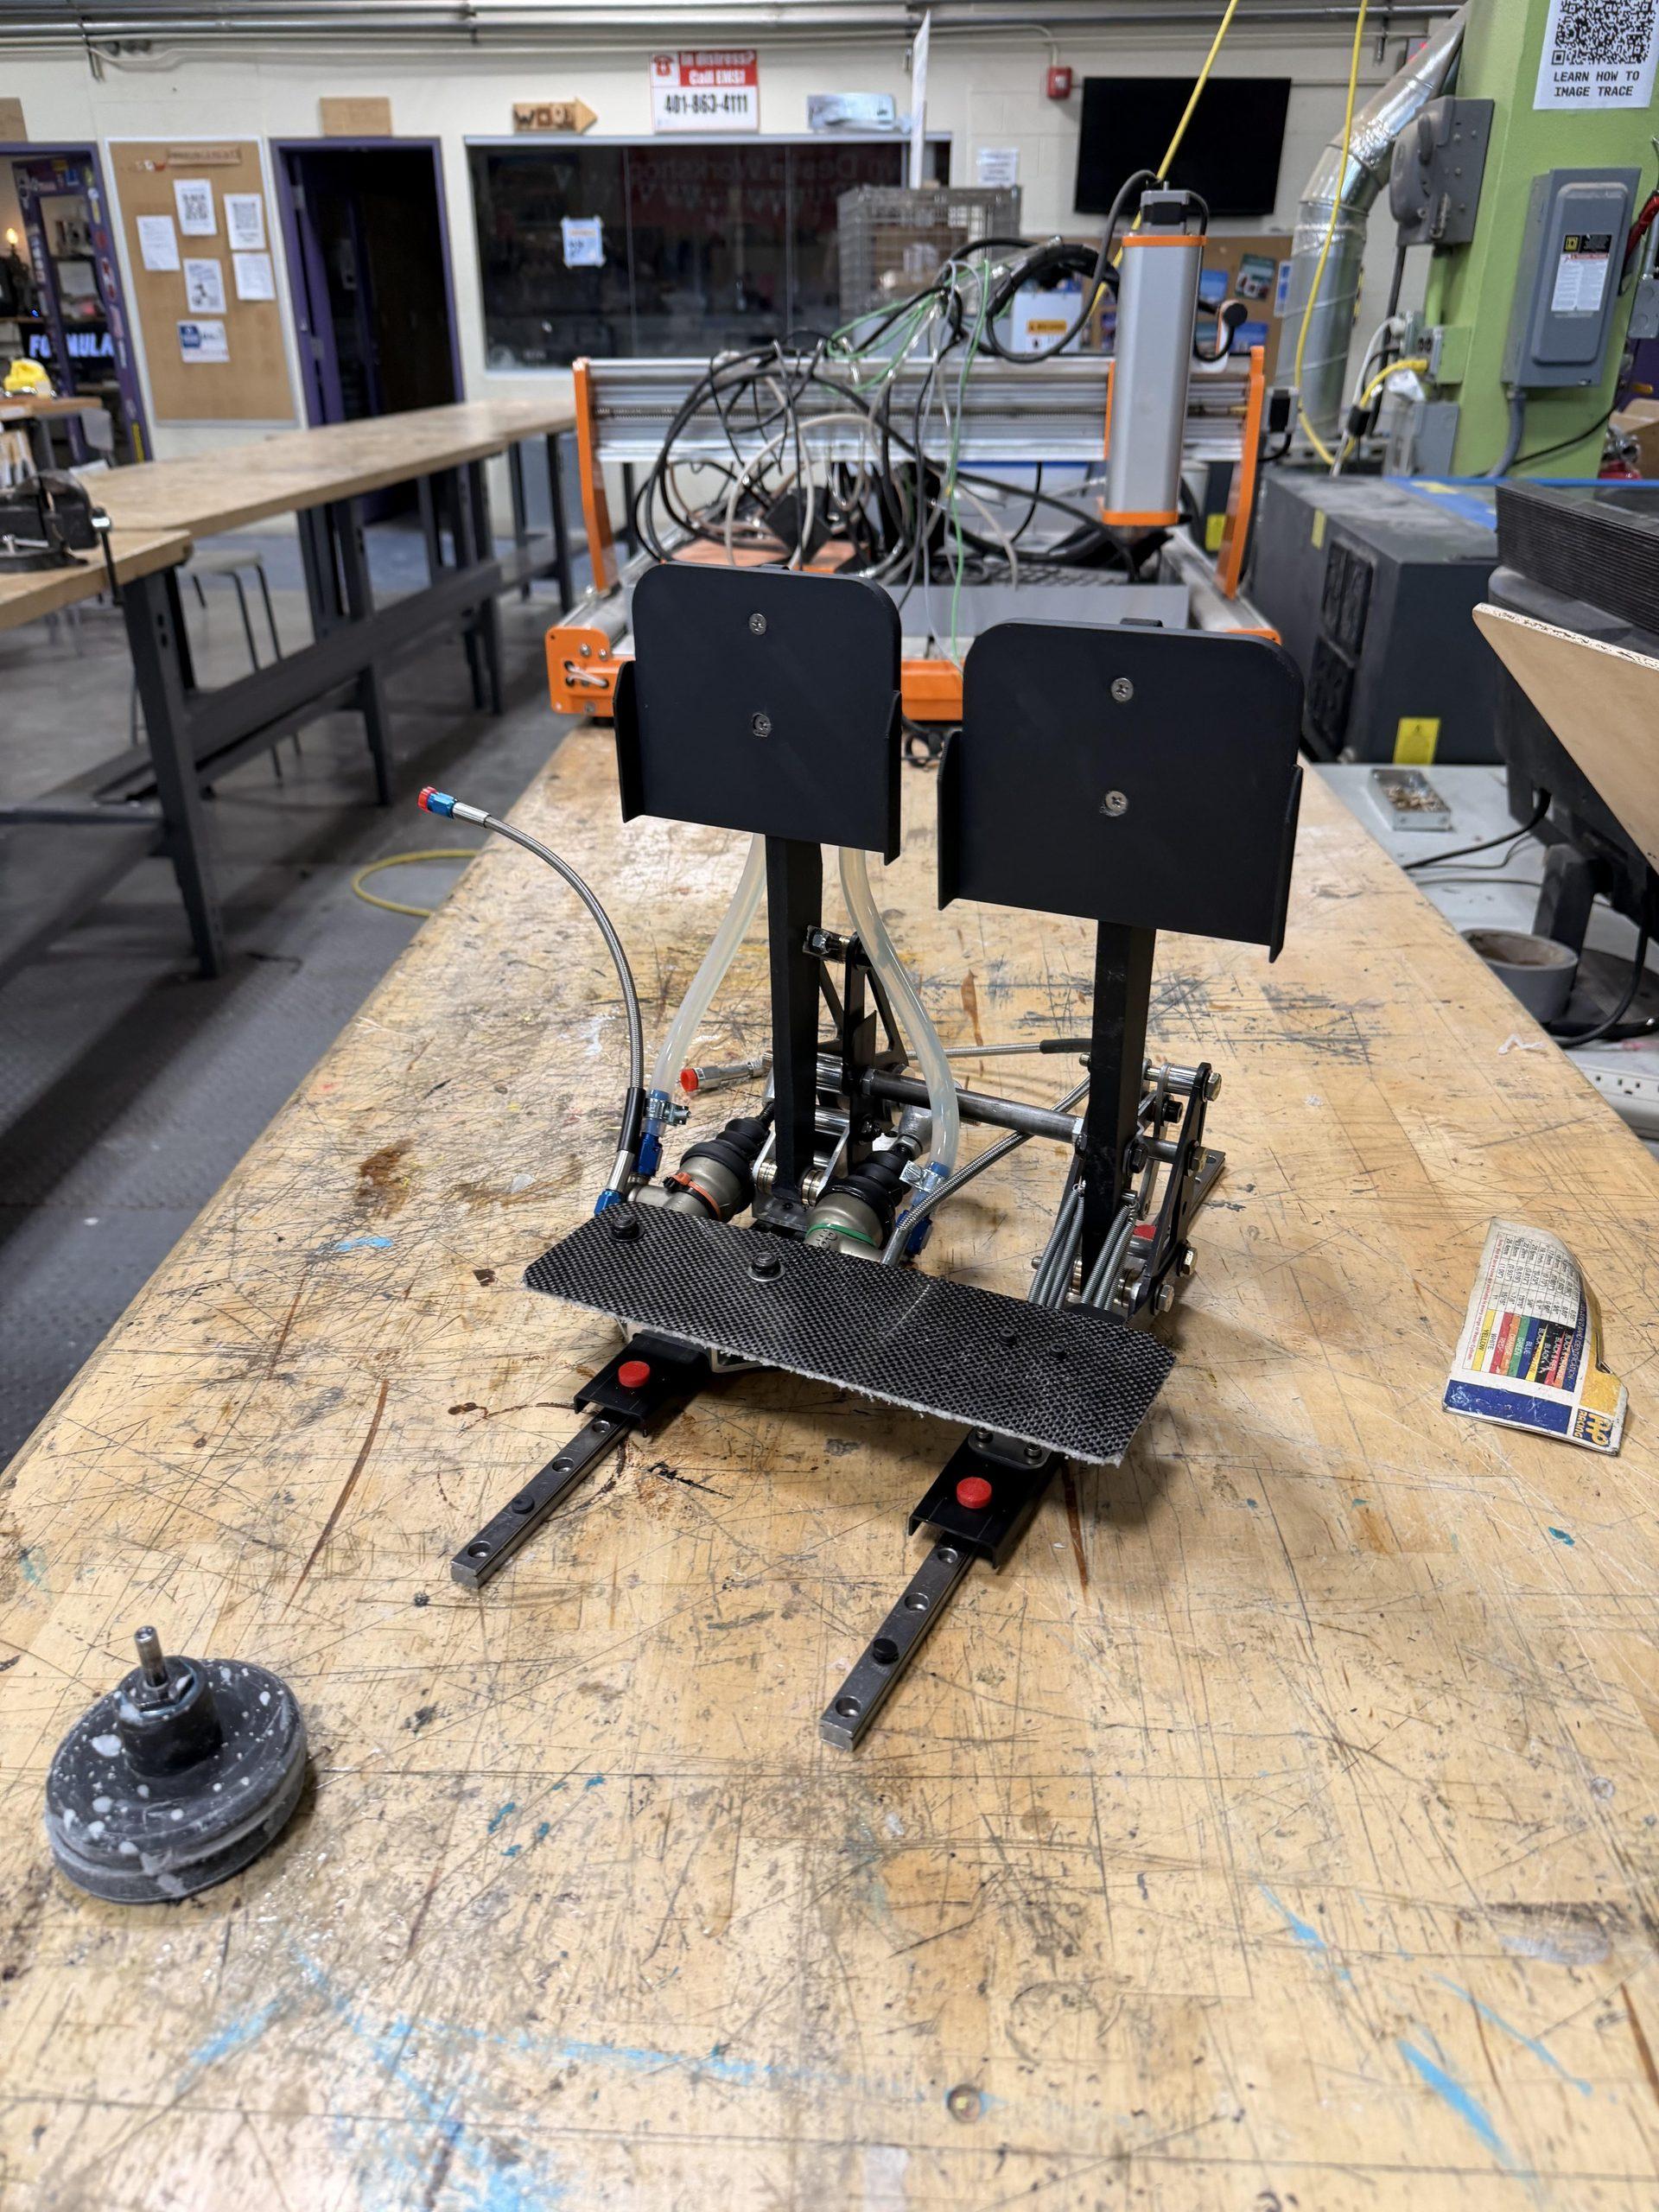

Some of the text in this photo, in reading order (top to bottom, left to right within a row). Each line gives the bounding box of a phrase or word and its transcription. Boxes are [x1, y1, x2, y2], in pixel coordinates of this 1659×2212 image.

[689, 69, 715, 85] Call
[1554, 71, 1640, 82] LEARN HOW TO
[1554, 86, 1634, 97] IMAGE TRACE
[664, 93, 748, 114] 401-863-4111
[29, 333, 115, 359] FOMULA
[1478, 1328, 1489, 1351] YELLOW
[1488, 1332, 1497, 1351] WHITE
[1504, 1332, 1516, 1356] ORANGE
[1535, 1327, 1545, 1345] BLACK
[1552, 1336, 1562, 1355] BLACK
[1562, 1333, 1572, 1351] BLACK
[1514, 1336, 1524, 1356] GREEN
[1523, 1340, 1533, 1355] BLUE
[1541, 1342, 1551, 1360] BLACK
[1556, 1356, 1567, 1380] ORANGE
[1573, 1410, 1588, 1438] RACING
[1585, 1413, 1612, 1446] AP
